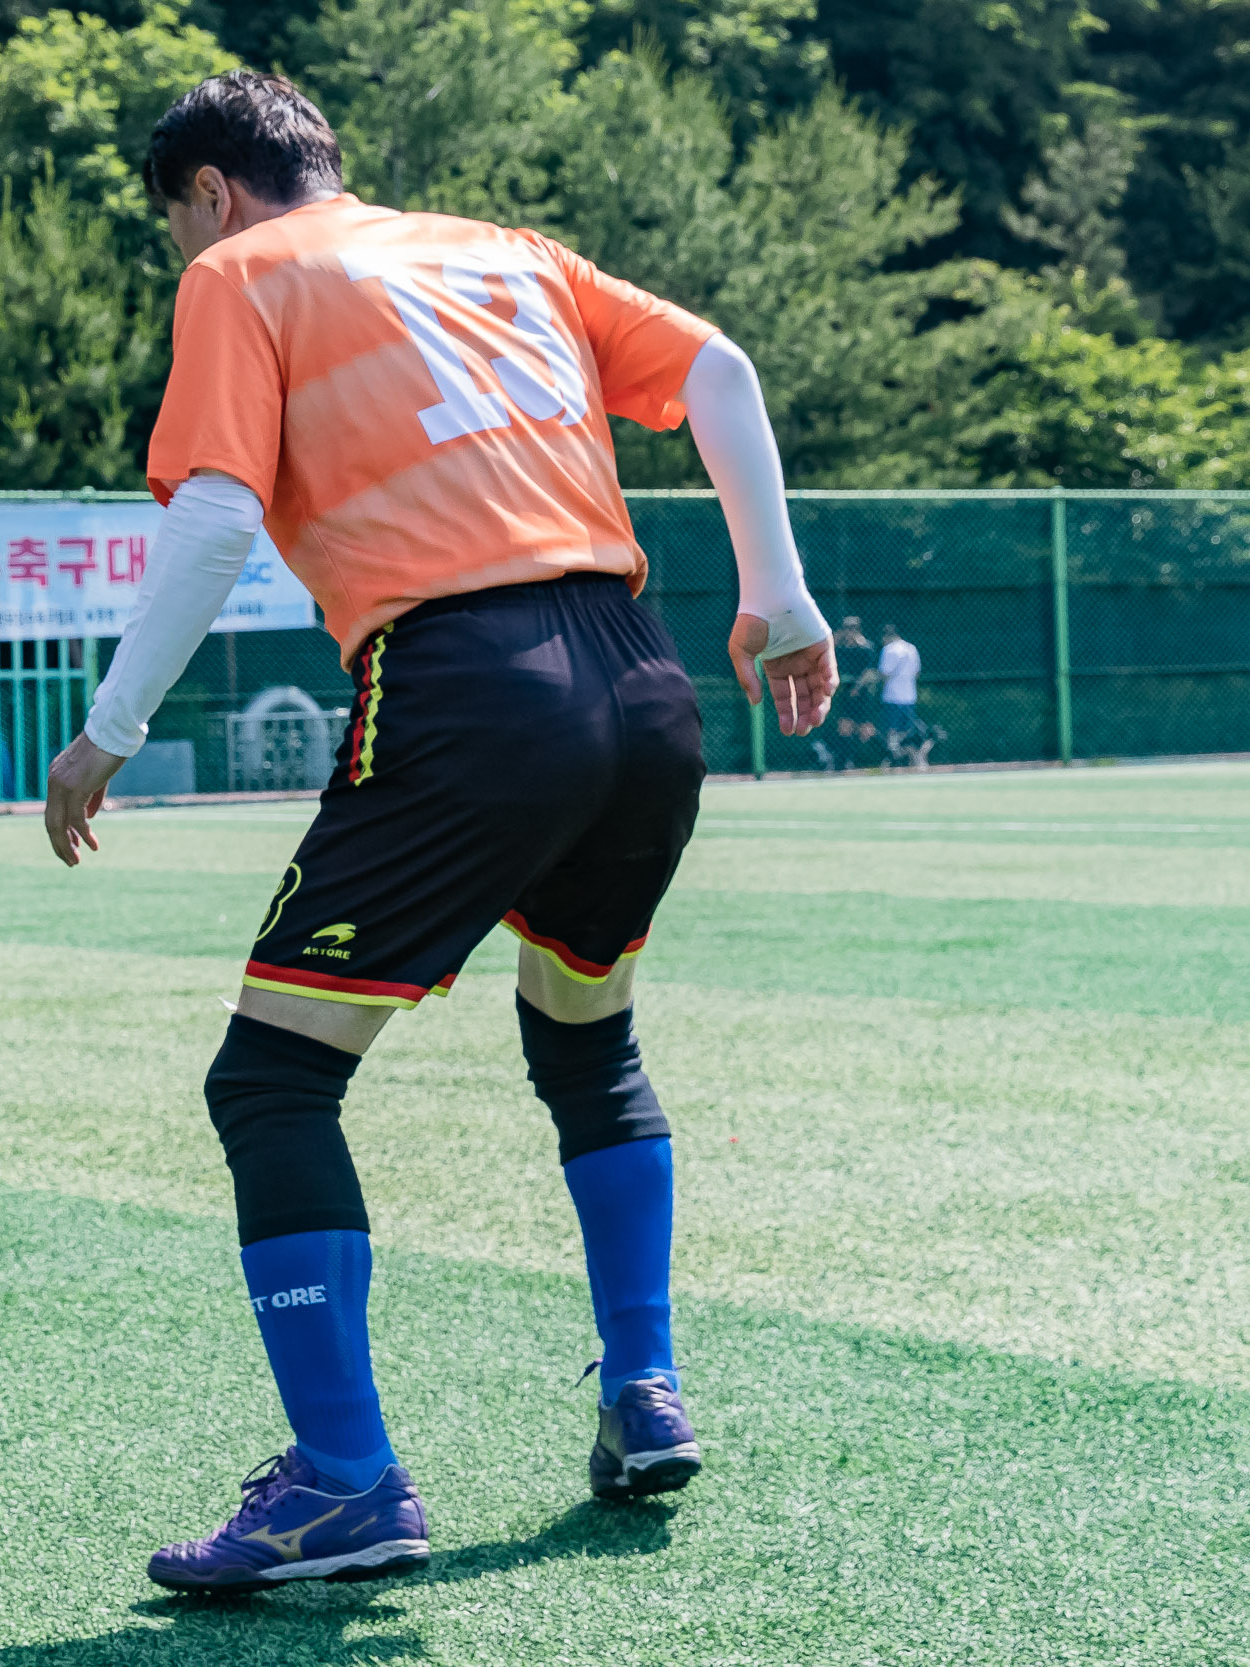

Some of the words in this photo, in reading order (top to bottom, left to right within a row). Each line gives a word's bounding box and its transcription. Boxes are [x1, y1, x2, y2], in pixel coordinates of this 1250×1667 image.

[337, 244, 588, 446] 13
[302, 946, 351, 960] ASTORE
[251, 1284, 327, 1313] TORE
